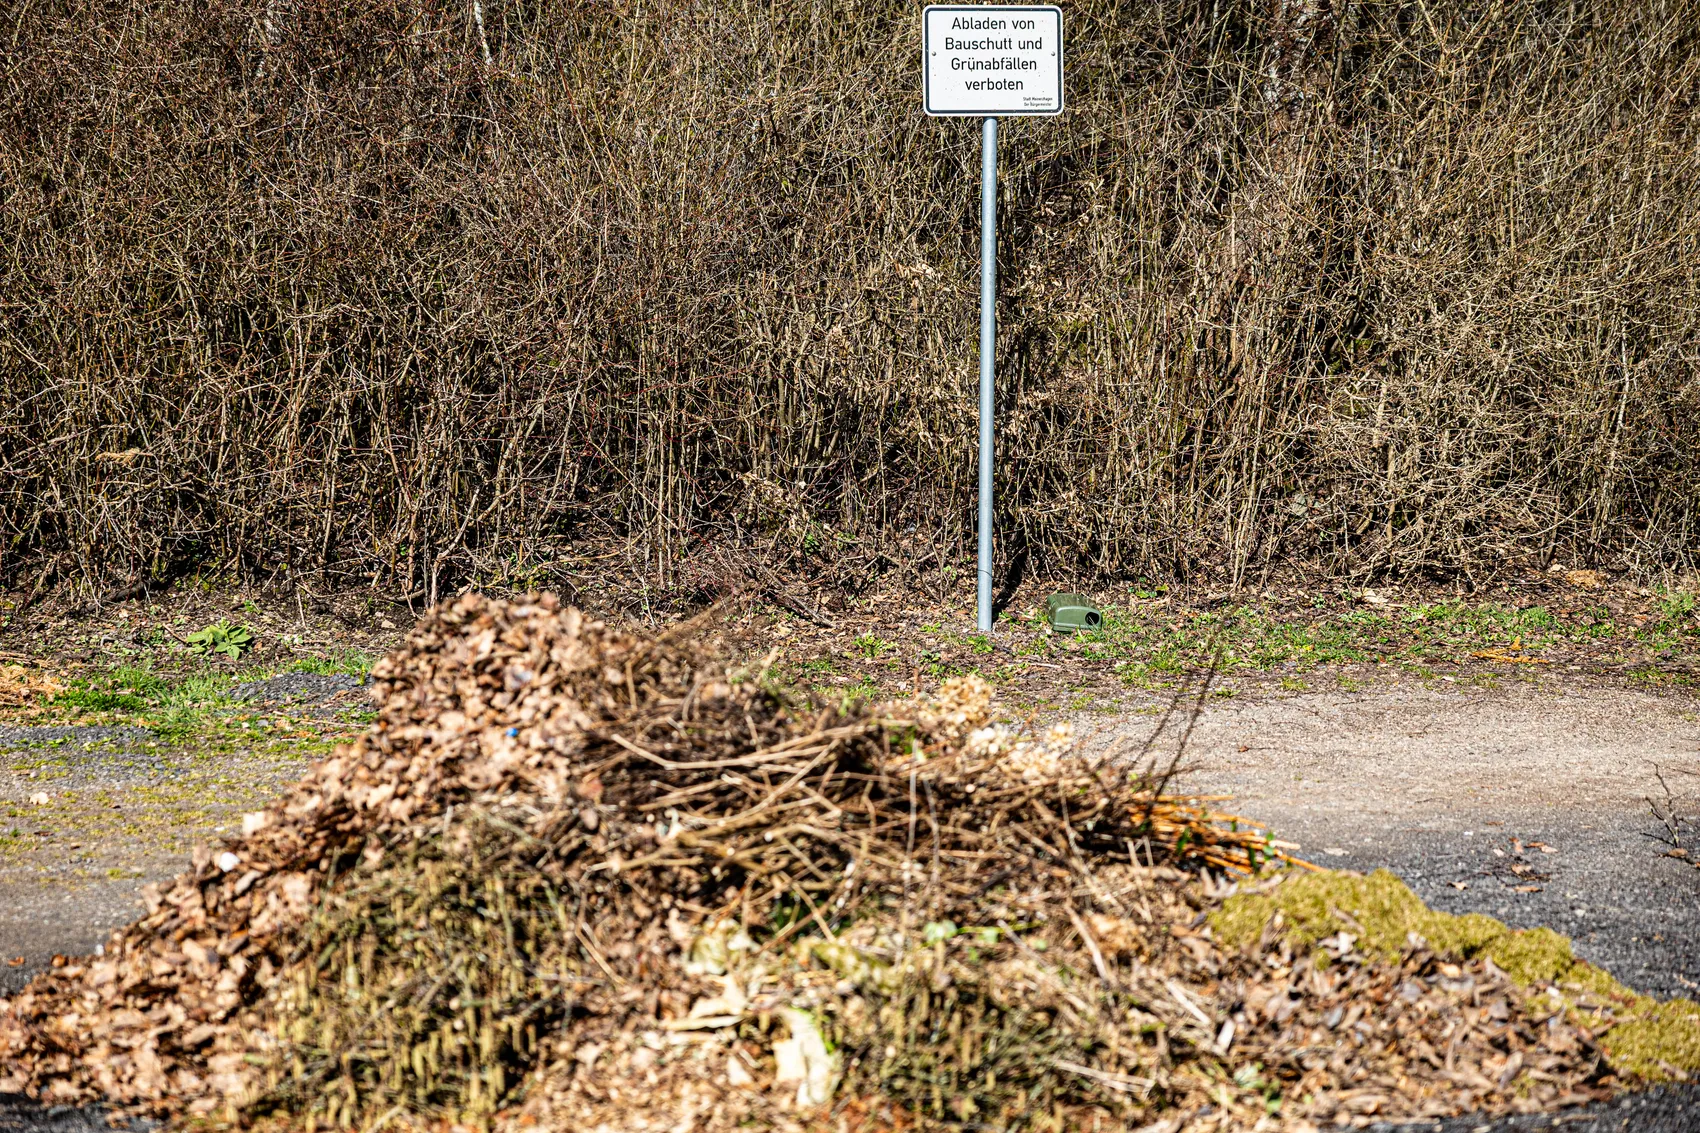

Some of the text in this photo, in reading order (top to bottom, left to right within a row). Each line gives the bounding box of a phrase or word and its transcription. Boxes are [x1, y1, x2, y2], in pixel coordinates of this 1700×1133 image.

[951, 17, 1035, 30] Abladen von
[945, 37, 1042, 50] Bauschutt und
[951, 57, 1037, 70] Grünabfällen
[965, 78, 1024, 90] verboten
